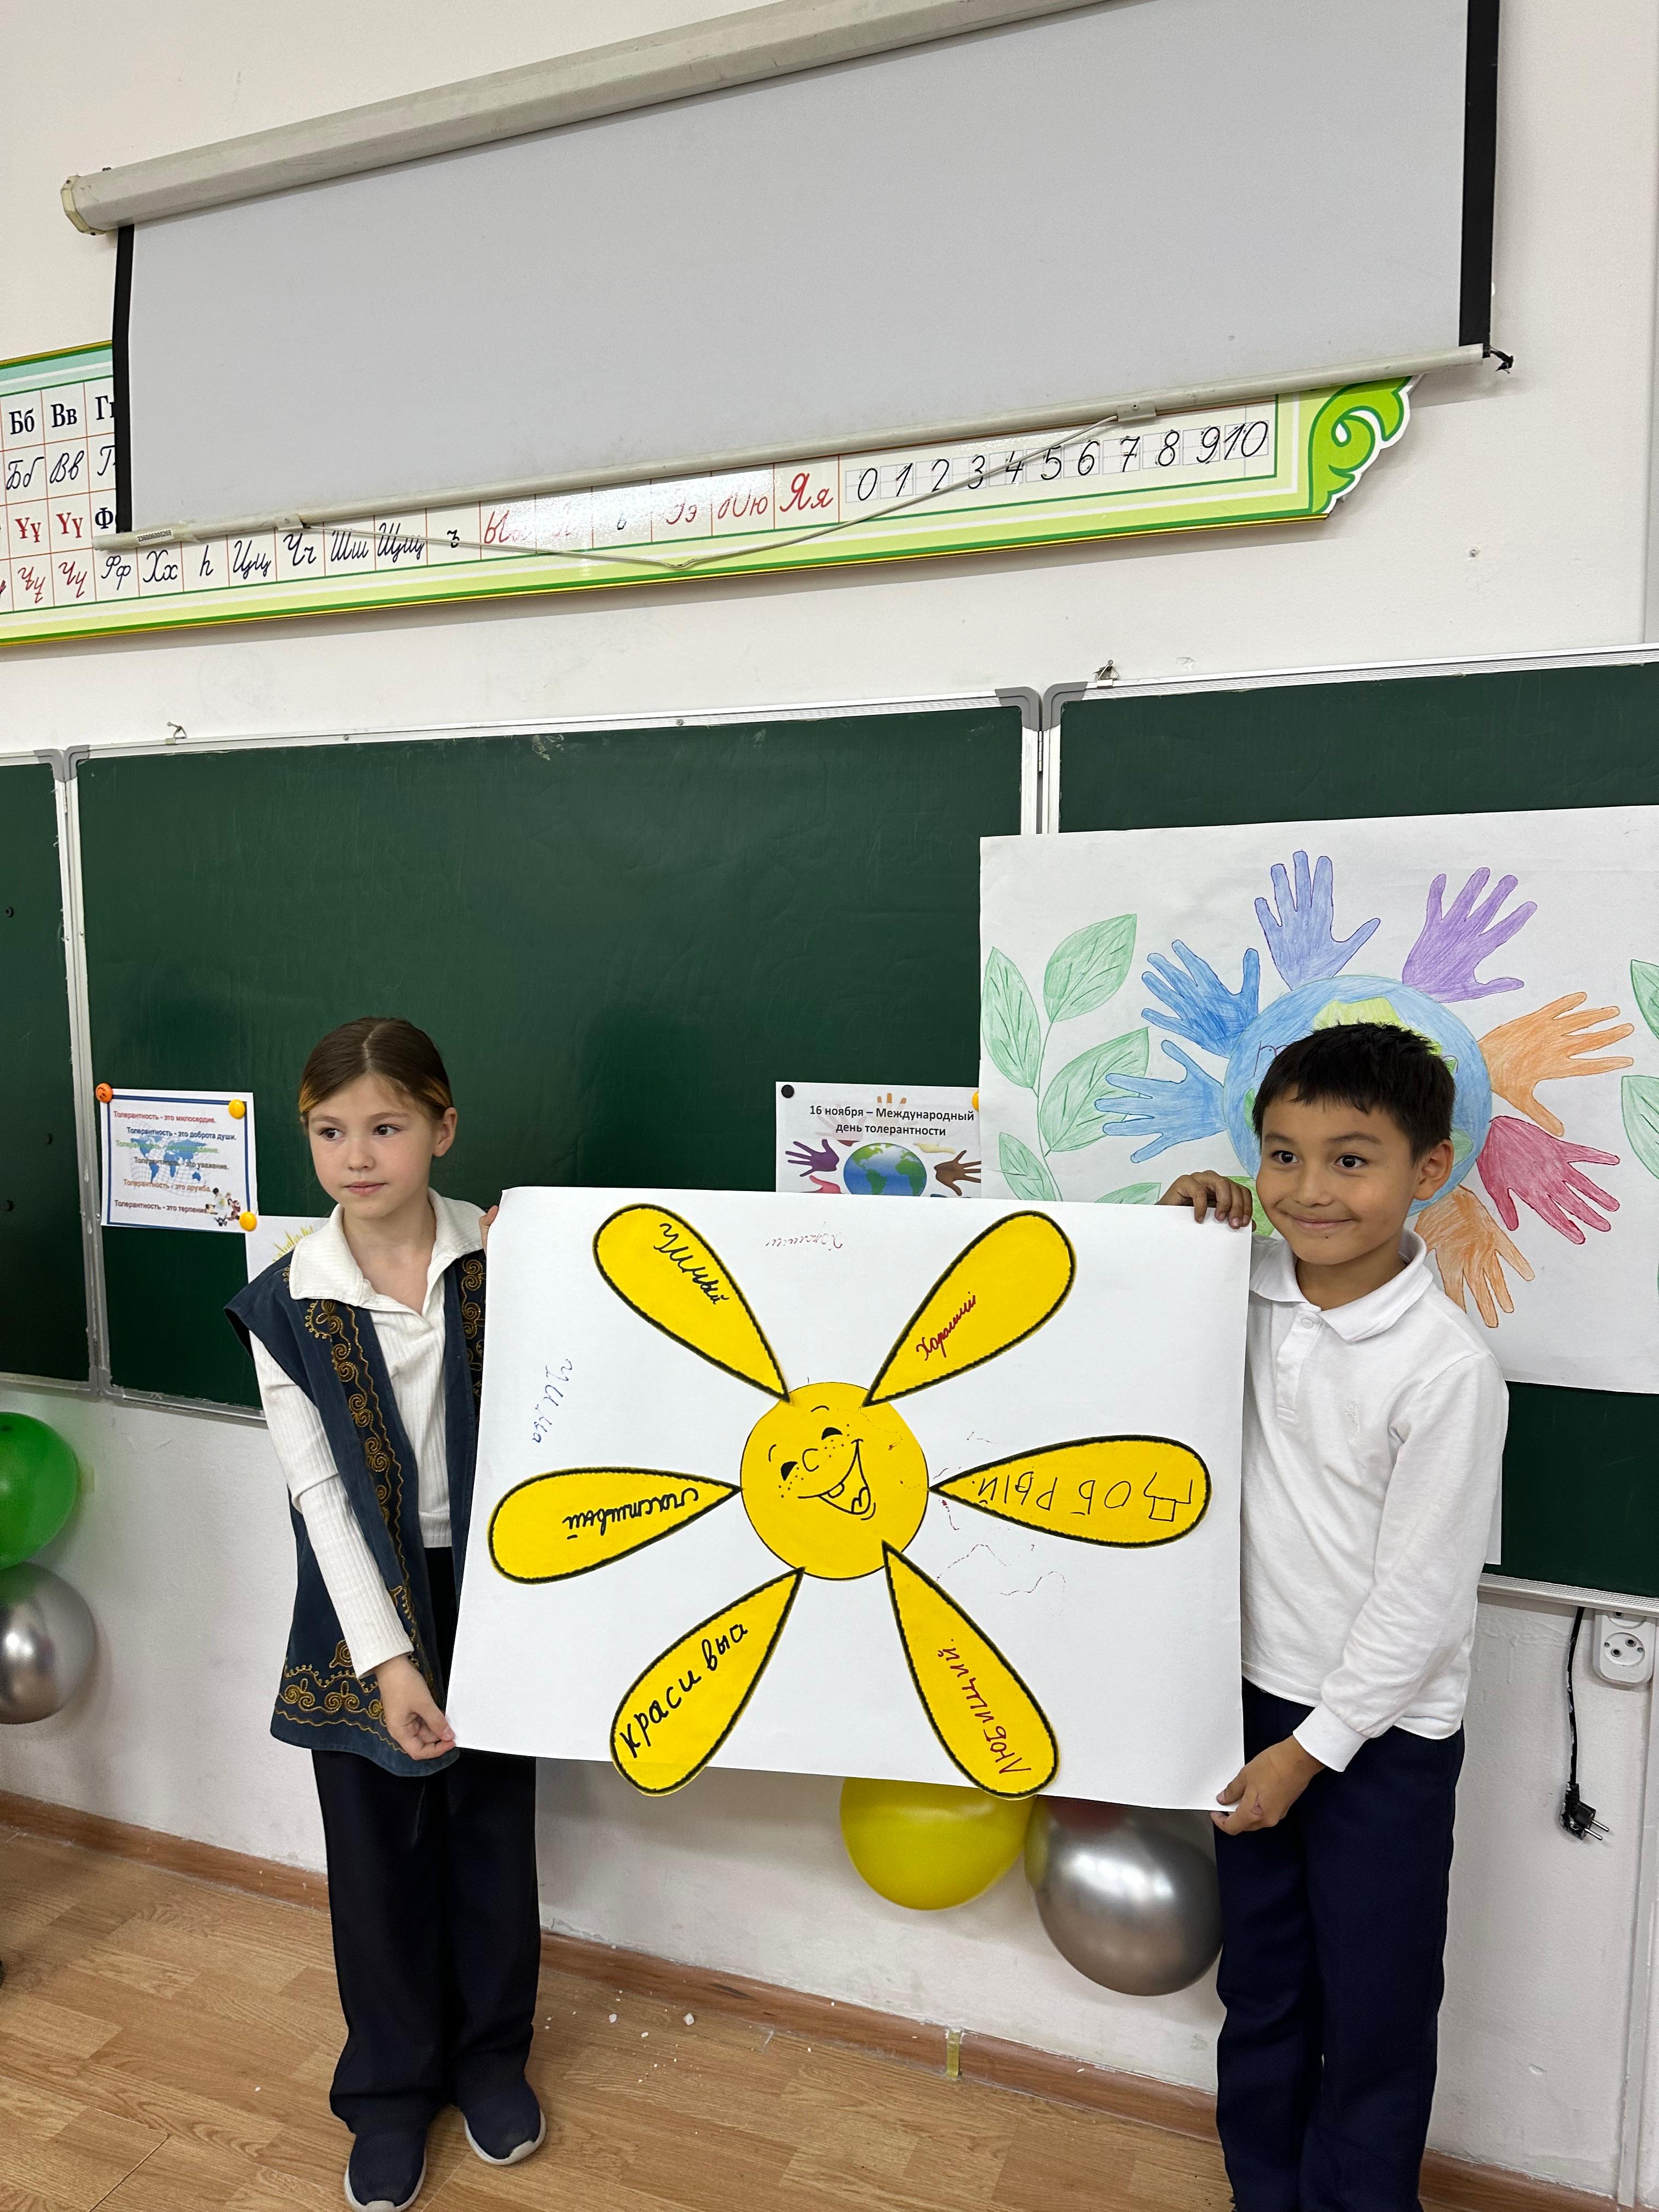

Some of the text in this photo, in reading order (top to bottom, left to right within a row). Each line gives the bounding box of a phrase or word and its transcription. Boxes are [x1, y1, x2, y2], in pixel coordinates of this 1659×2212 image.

[9, 408, 35, 435] Бб
[50, 403, 77, 427] Вв
[6, 445, 116, 490] Бб Вв Г
[857, 420, 1268, 501] 0 1 2 3 4 5 6 7 8 9 10
[95, 507, 116, 529] Ф
[101, 555, 131, 590] Фф
[143, 549, 178, 583] Хх
[233, 540, 272, 579] Цц
[283, 533, 317, 566] Чч
[331, 528, 369, 562] Шш
[377, 522, 425, 563] Щщ
[780, 472, 833, 512] Яя
[114, 1111, 159, 1120] Толерантность
[810, 1105, 822, 1115] 16
[825, 1105, 864, 1118] ноября
[876, 1108, 974, 1121] Международный
[127, 1127, 173, 1136] Толерантность
[190, 1131, 216, 1139] доброта
[836, 1124, 946, 1136] день толерантности
[123, 1179, 170, 1189] Толерантность
[114, 1200, 161, 1210] Толерантность
